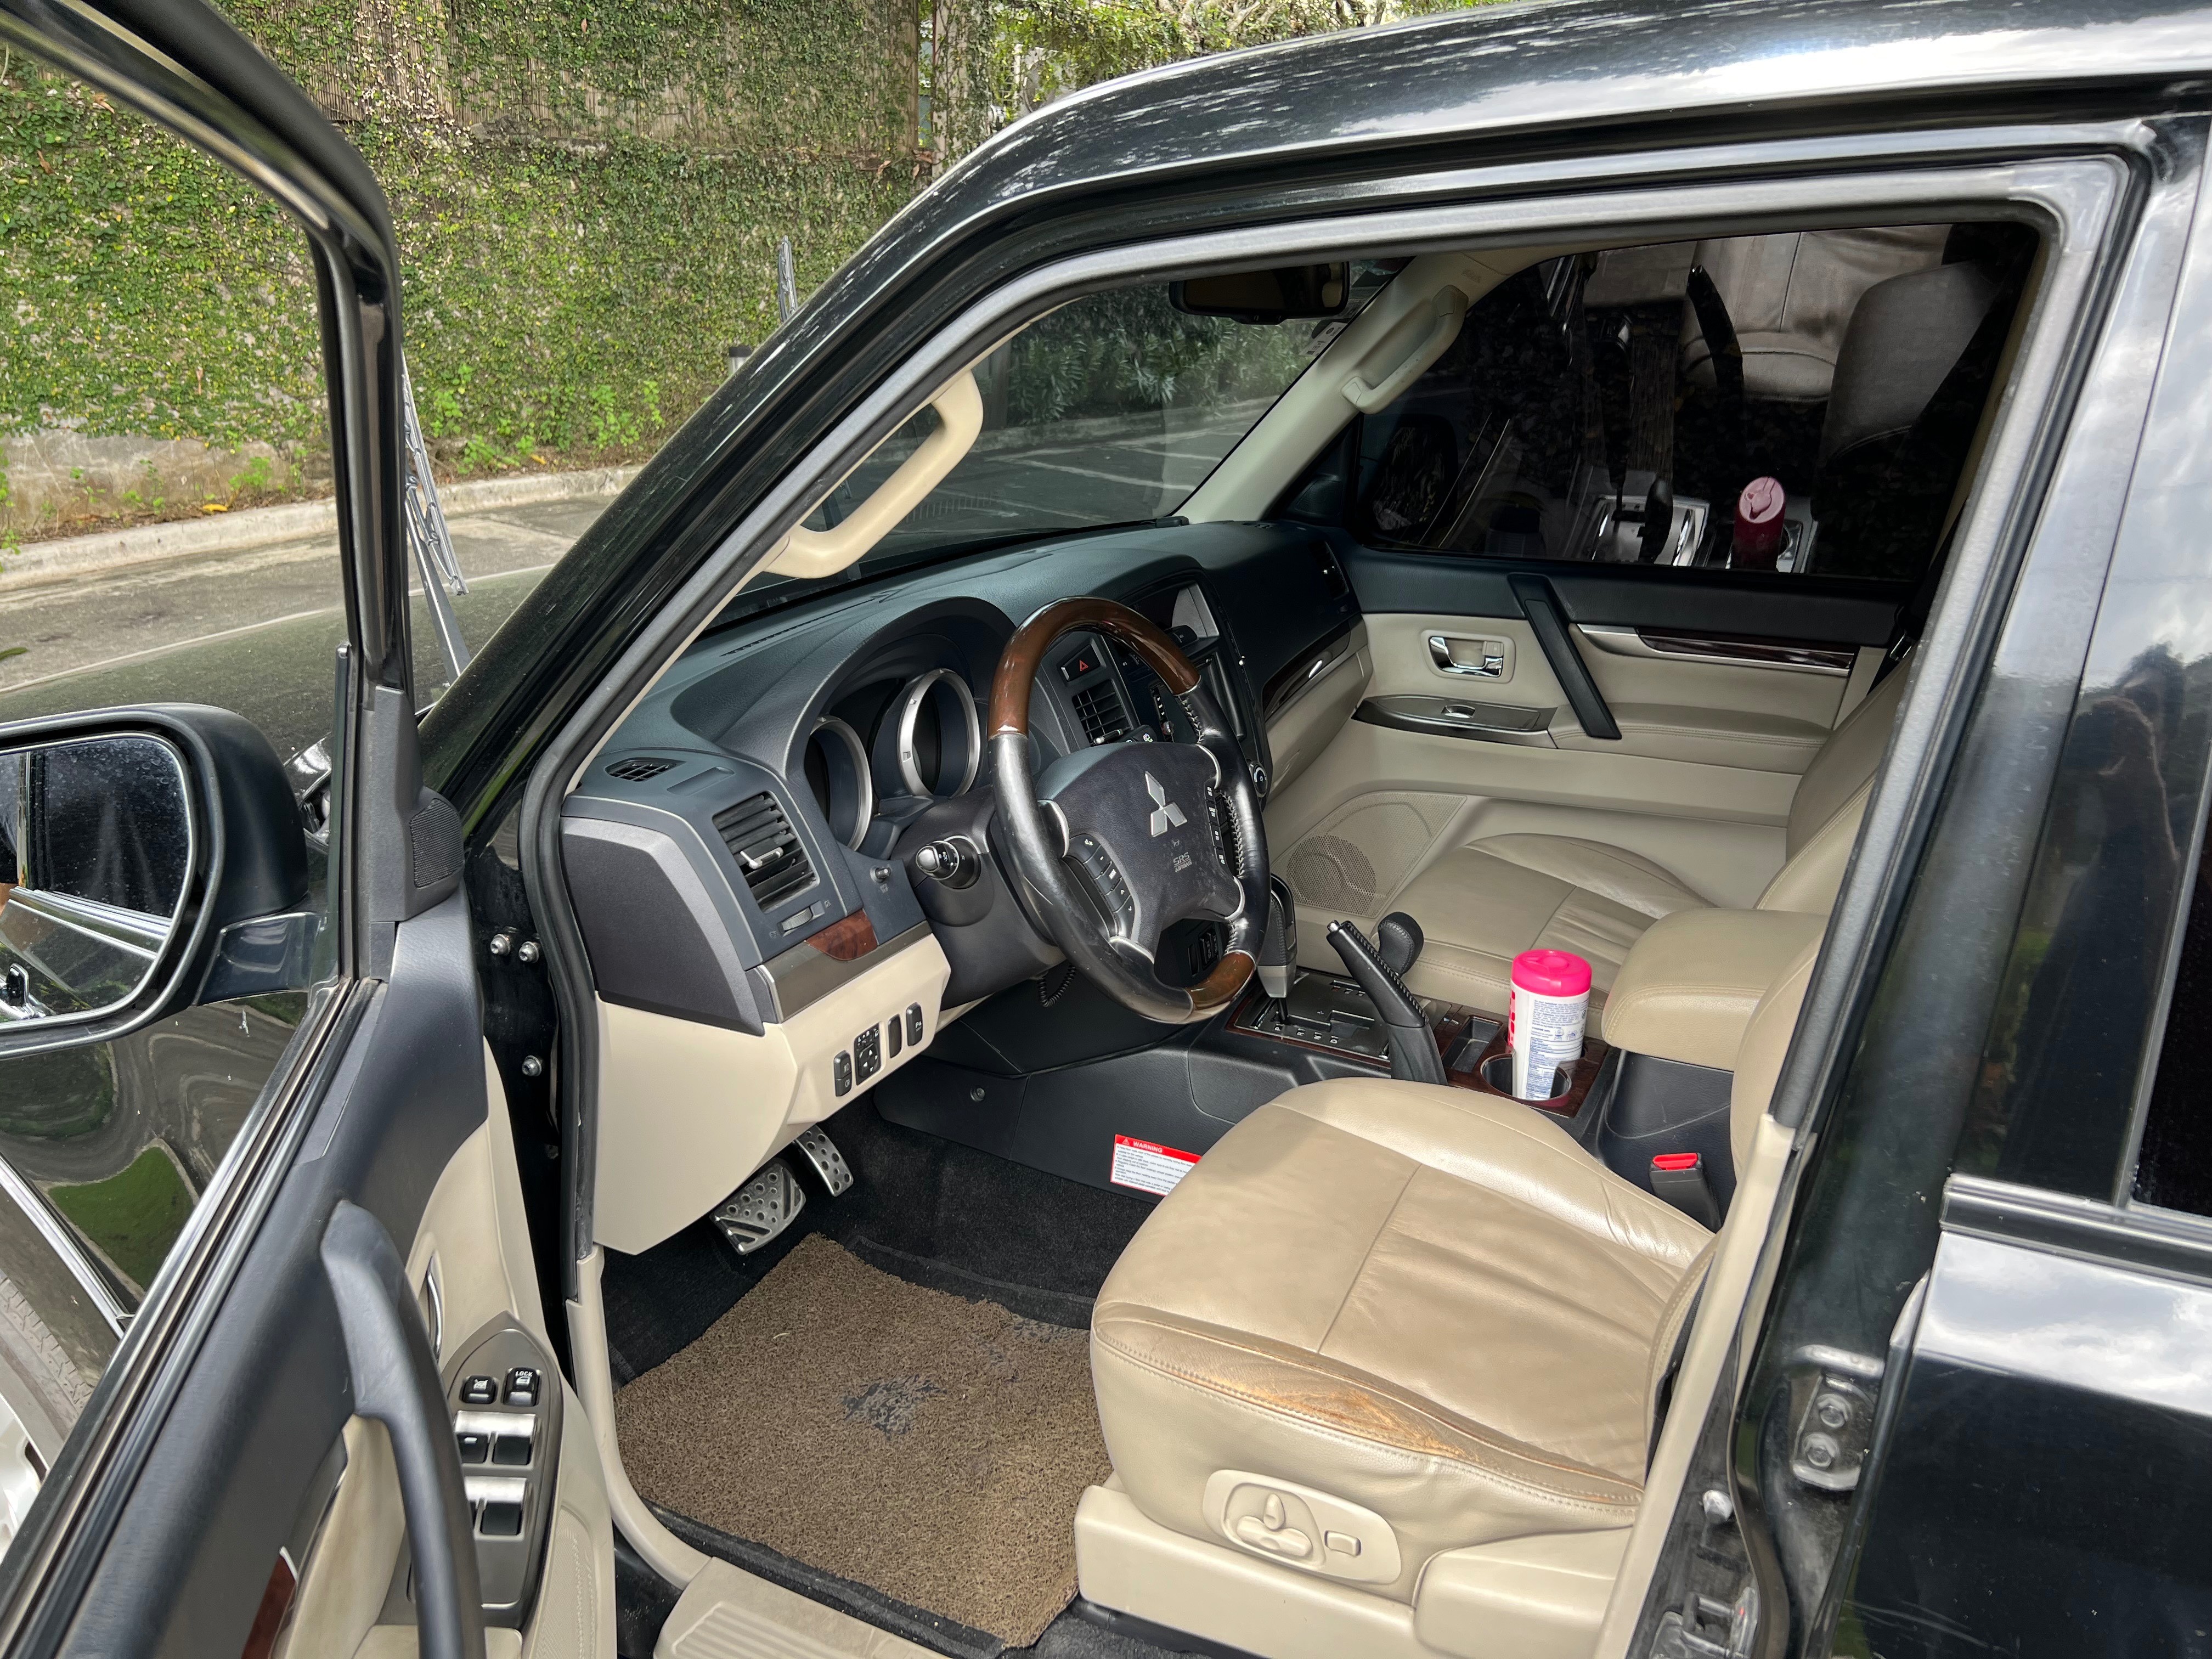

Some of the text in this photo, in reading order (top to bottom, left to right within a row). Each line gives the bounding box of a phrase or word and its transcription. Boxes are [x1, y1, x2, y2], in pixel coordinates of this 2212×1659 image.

[1173, 852, 1190, 865] SRS
[1175, 858, 1192, 873] AIRBAG
[1133, 1141, 1163, 1153] WARNING
